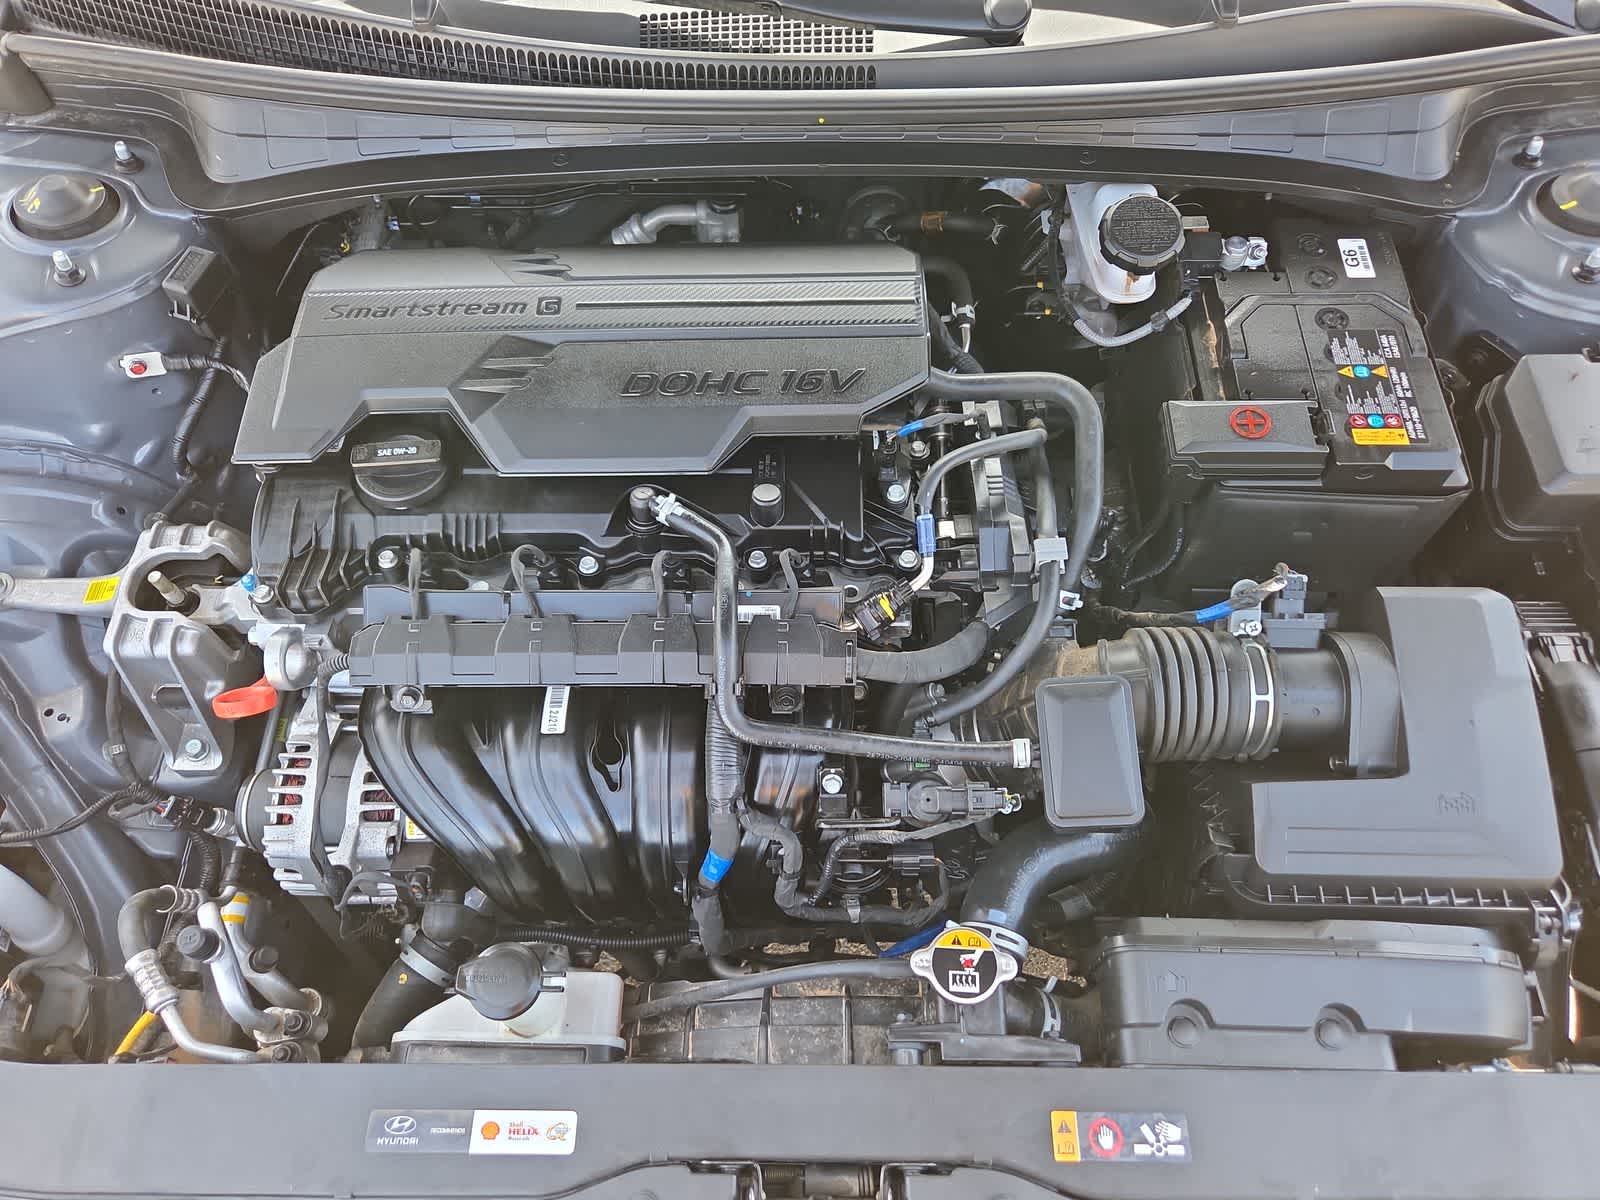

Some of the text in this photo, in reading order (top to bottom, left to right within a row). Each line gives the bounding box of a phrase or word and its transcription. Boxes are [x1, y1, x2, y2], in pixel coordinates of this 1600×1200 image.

[1342, 249, 1360, 268] G6
[323, 300, 528, 321] Smartstream
[618, 368, 867, 398] DOHC 16V
[376, 446, 417, 457] SAE 0W-20
[376, 1136, 420, 1146] HYUNDAI
[507, 1127, 539, 1136] HELIX
